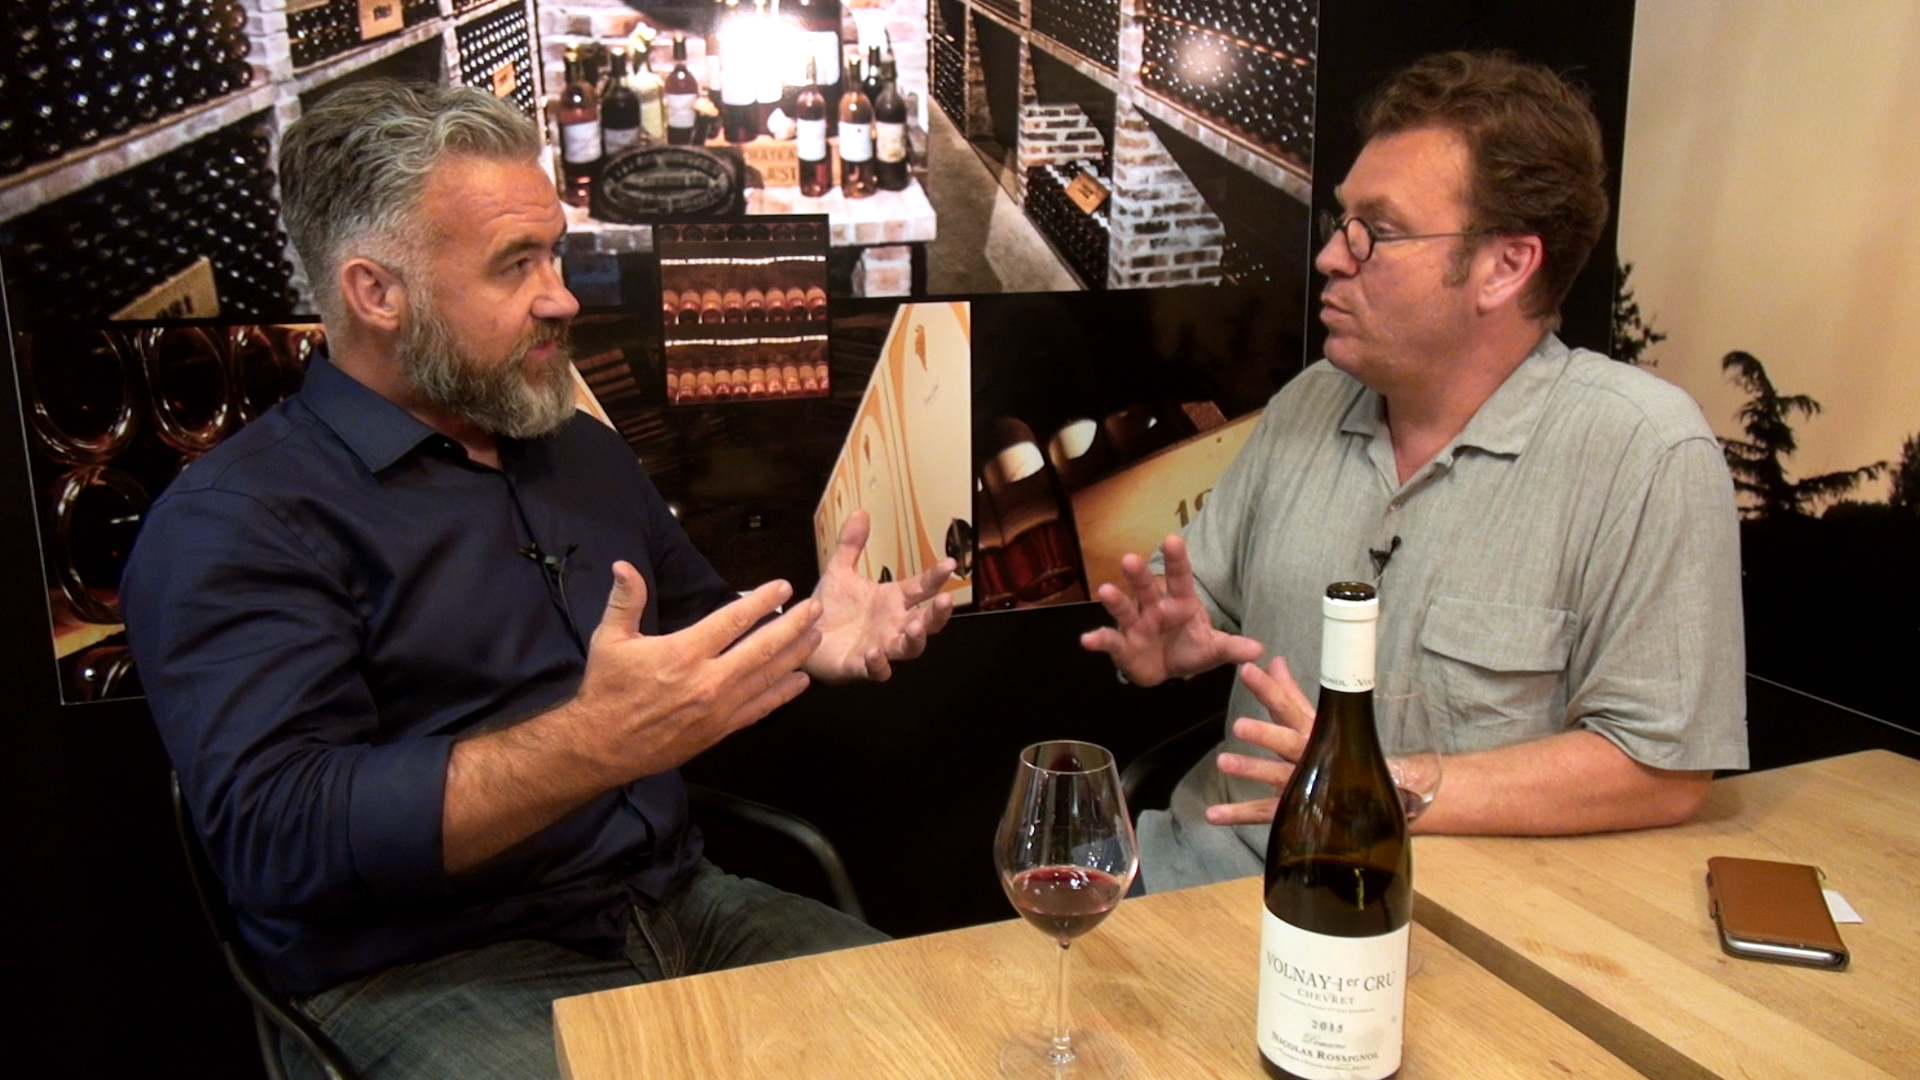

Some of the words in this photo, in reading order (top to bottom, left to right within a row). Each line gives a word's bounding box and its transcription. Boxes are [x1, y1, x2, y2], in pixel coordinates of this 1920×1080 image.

[1267, 950, 1332, 990] VOLNAY
[1338, 977, 1360, 992] 1er
[1363, 970, 1396, 992] CRU
[1297, 988, 1356, 1005] CHEVRET
[1311, 1020, 1344, 1033] 2015
